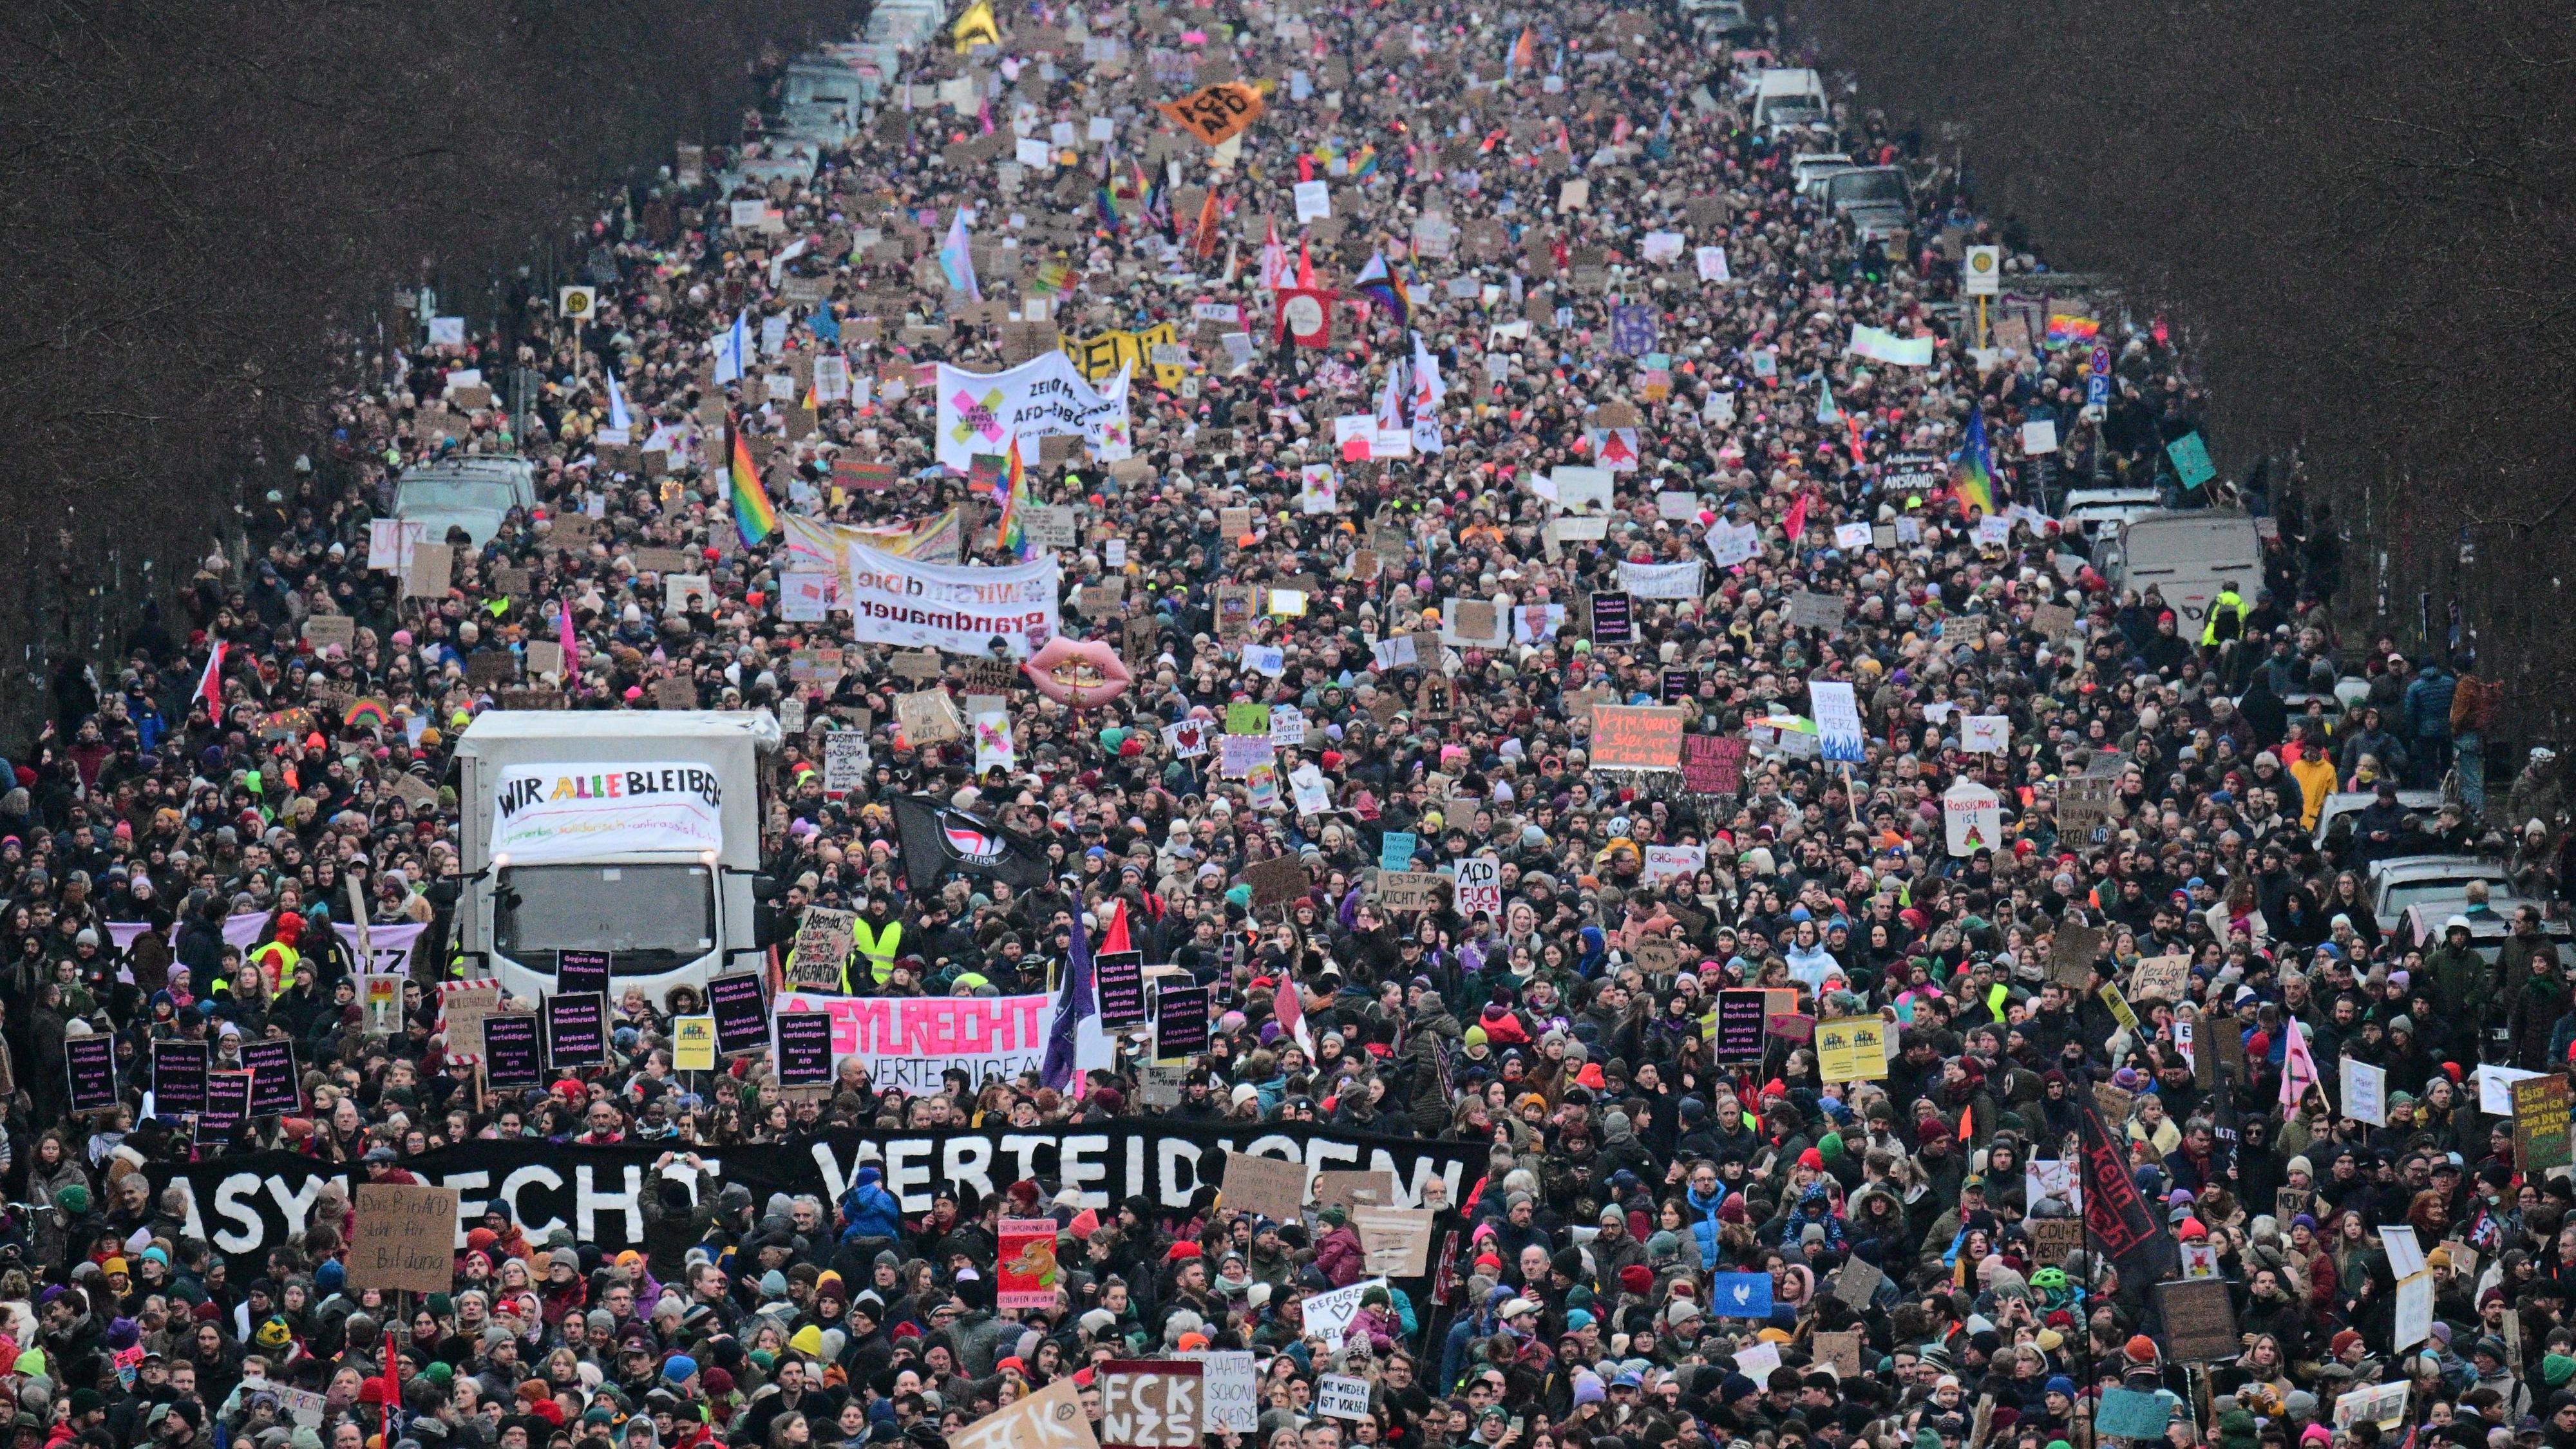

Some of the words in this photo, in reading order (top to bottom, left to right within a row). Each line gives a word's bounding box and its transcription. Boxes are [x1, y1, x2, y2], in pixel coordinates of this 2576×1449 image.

[1175, 721, 1197, 734] HERZ
[1823, 715, 1853, 730] MERZ
[1177, 743, 1206, 755] MERZ
[498, 777, 544, 819] WIR
[549, 773, 623, 800] ALLE
[626, 770, 721, 809] BLEIBEN
[1963, 812, 1978, 824] ist
[960, 853, 997, 864] AKTION
[1388, 875, 1402, 886] ES
[1381, 890, 1417, 905] NICHT
[1459, 886, 1500, 903] FUCK
[806, 909, 840, 929] Agenda
[564, 955, 587, 963] Gegen
[789, 965, 840, 983] MIGRATION
[788, 996, 1048, 1055] SYLRECHT
[377, 1245, 444, 1274] Bildung
[1209, 1356, 1254, 1372] HATTEN
[1104, 1373, 1199, 1416] FCK
[1210, 1385, 1255, 1402] SCHON!
[1322, 1380, 1334, 1392] NIE
[1338, 1382, 1366, 1397] WIEDER
[1321, 1396, 1336, 1408] IST
[1339, 1398, 1367, 1415] VORBEI
[1104, 1412, 1200, 1444] NZS
